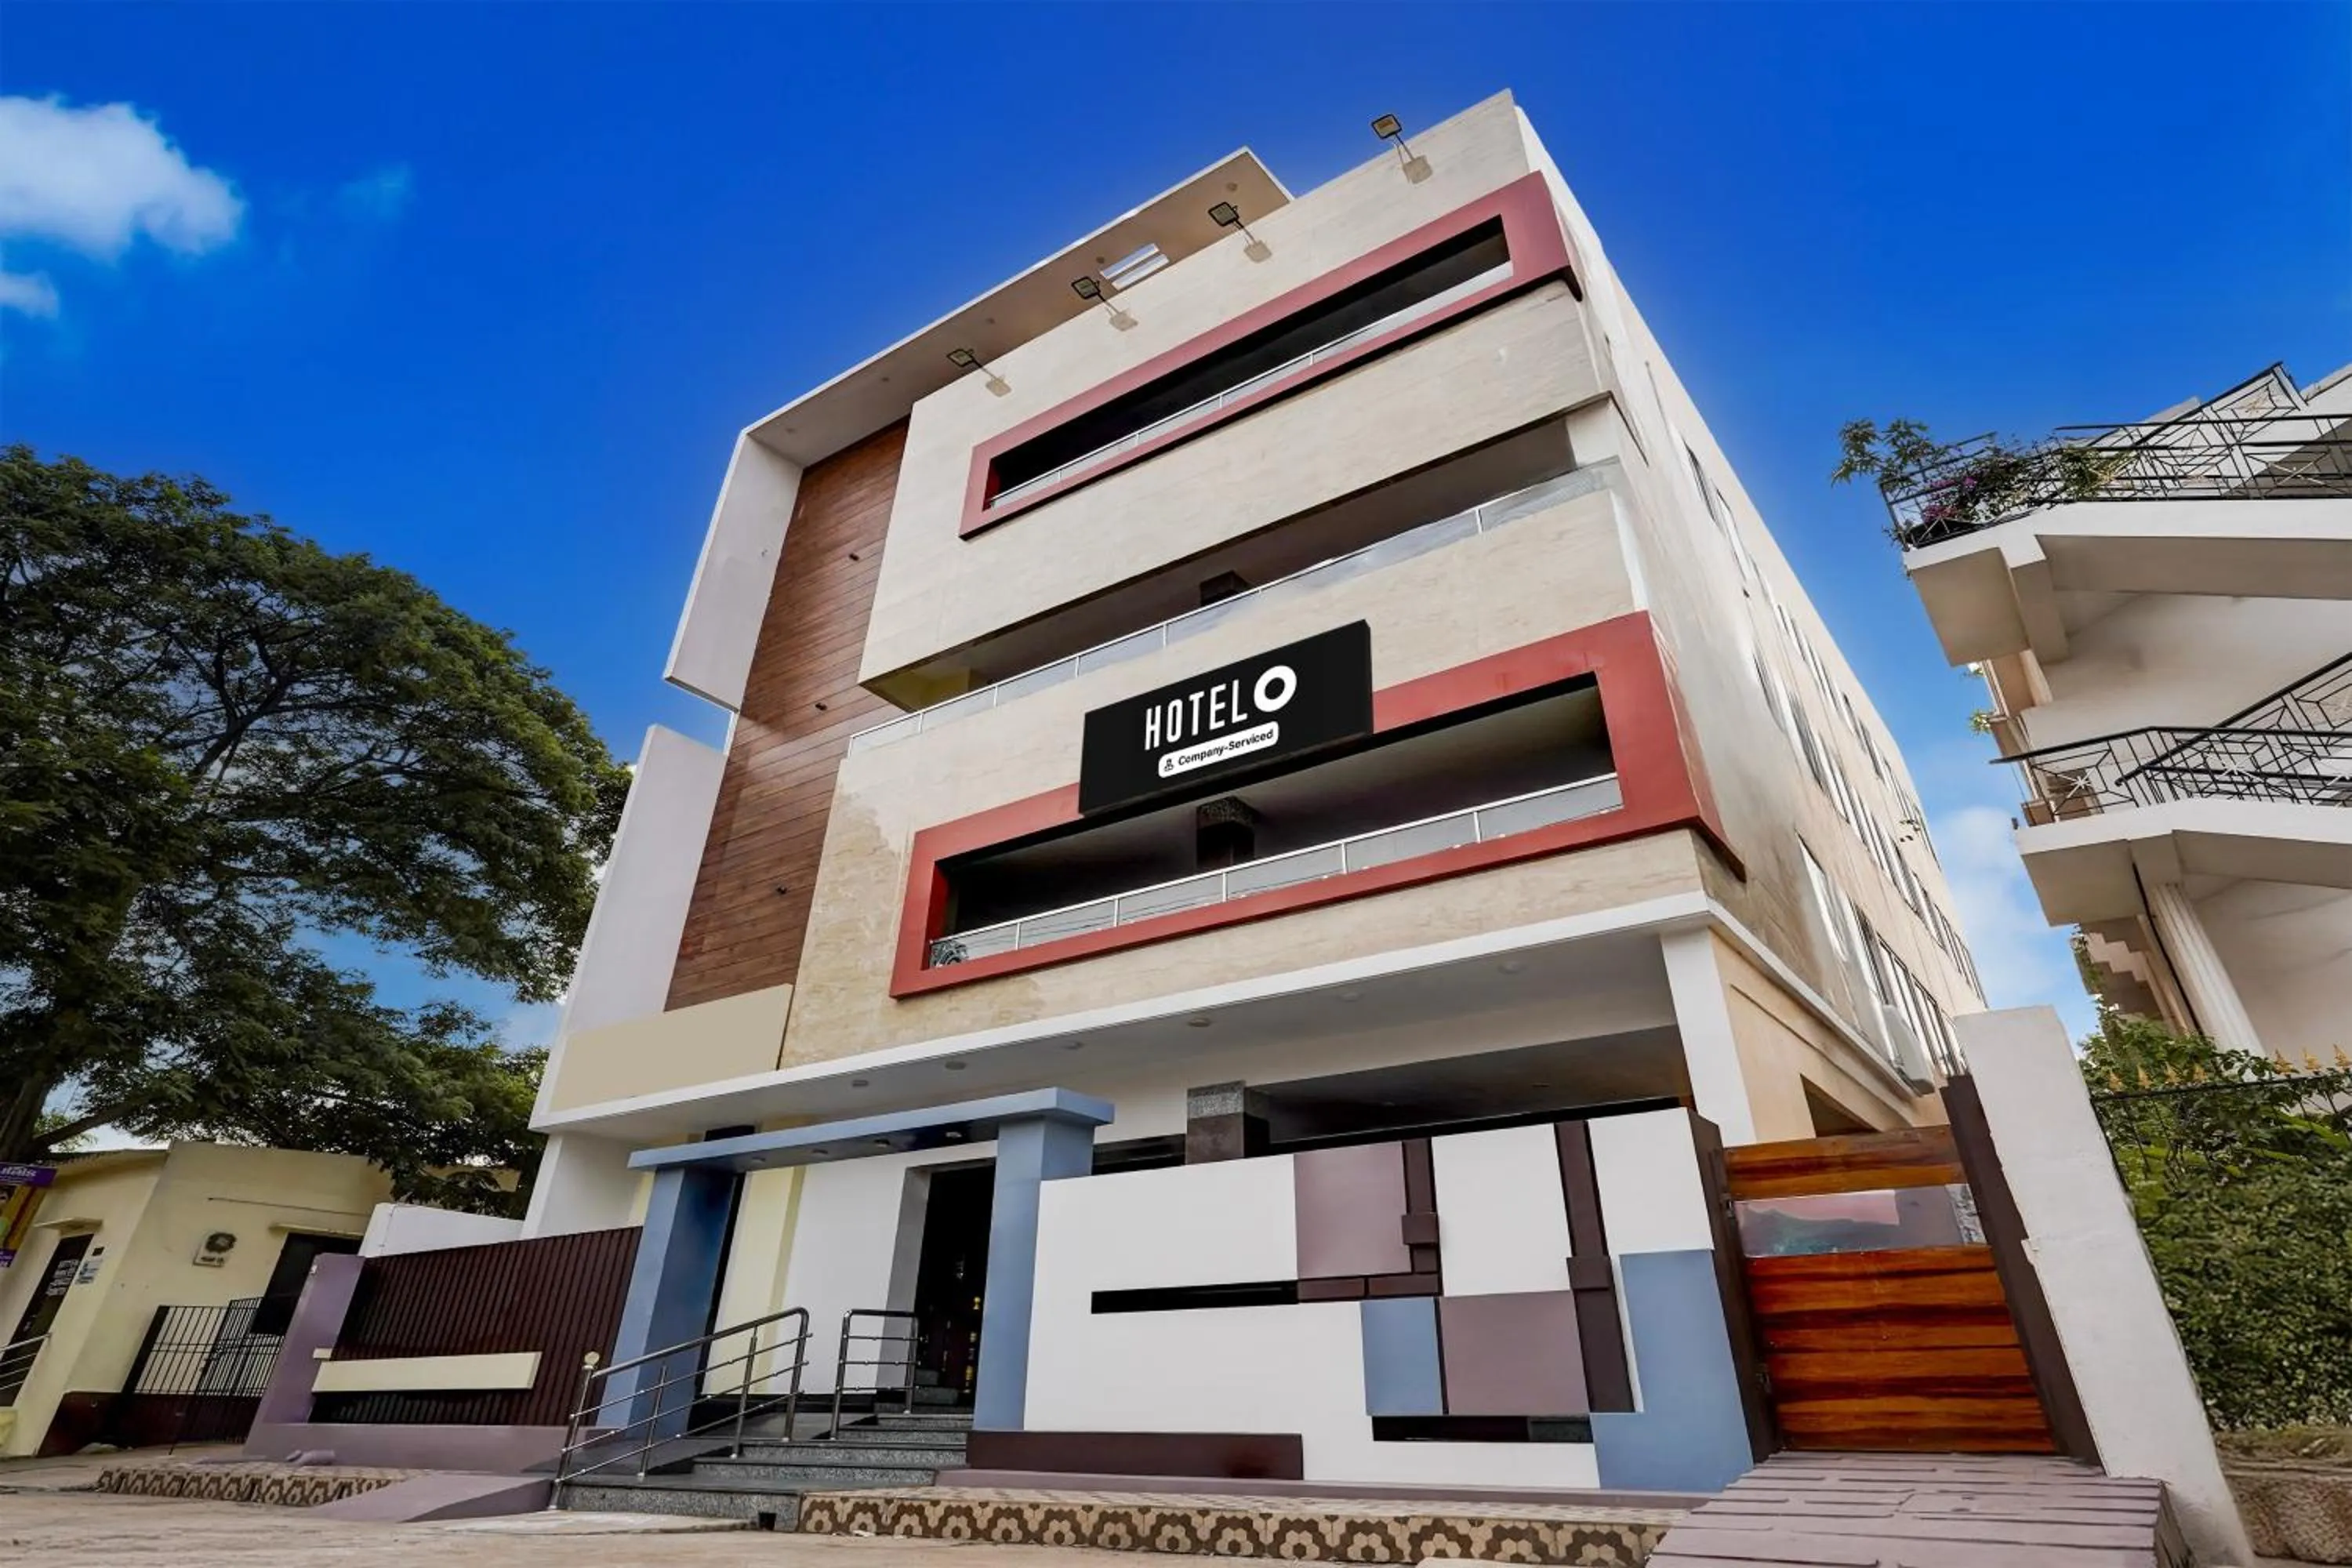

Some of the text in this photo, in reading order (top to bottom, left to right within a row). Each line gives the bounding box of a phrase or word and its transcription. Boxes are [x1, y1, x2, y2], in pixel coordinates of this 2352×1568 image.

[1145, 665, 1298, 750] HOTEL O
[1178, 728, 1274, 766] Company-Serviced
